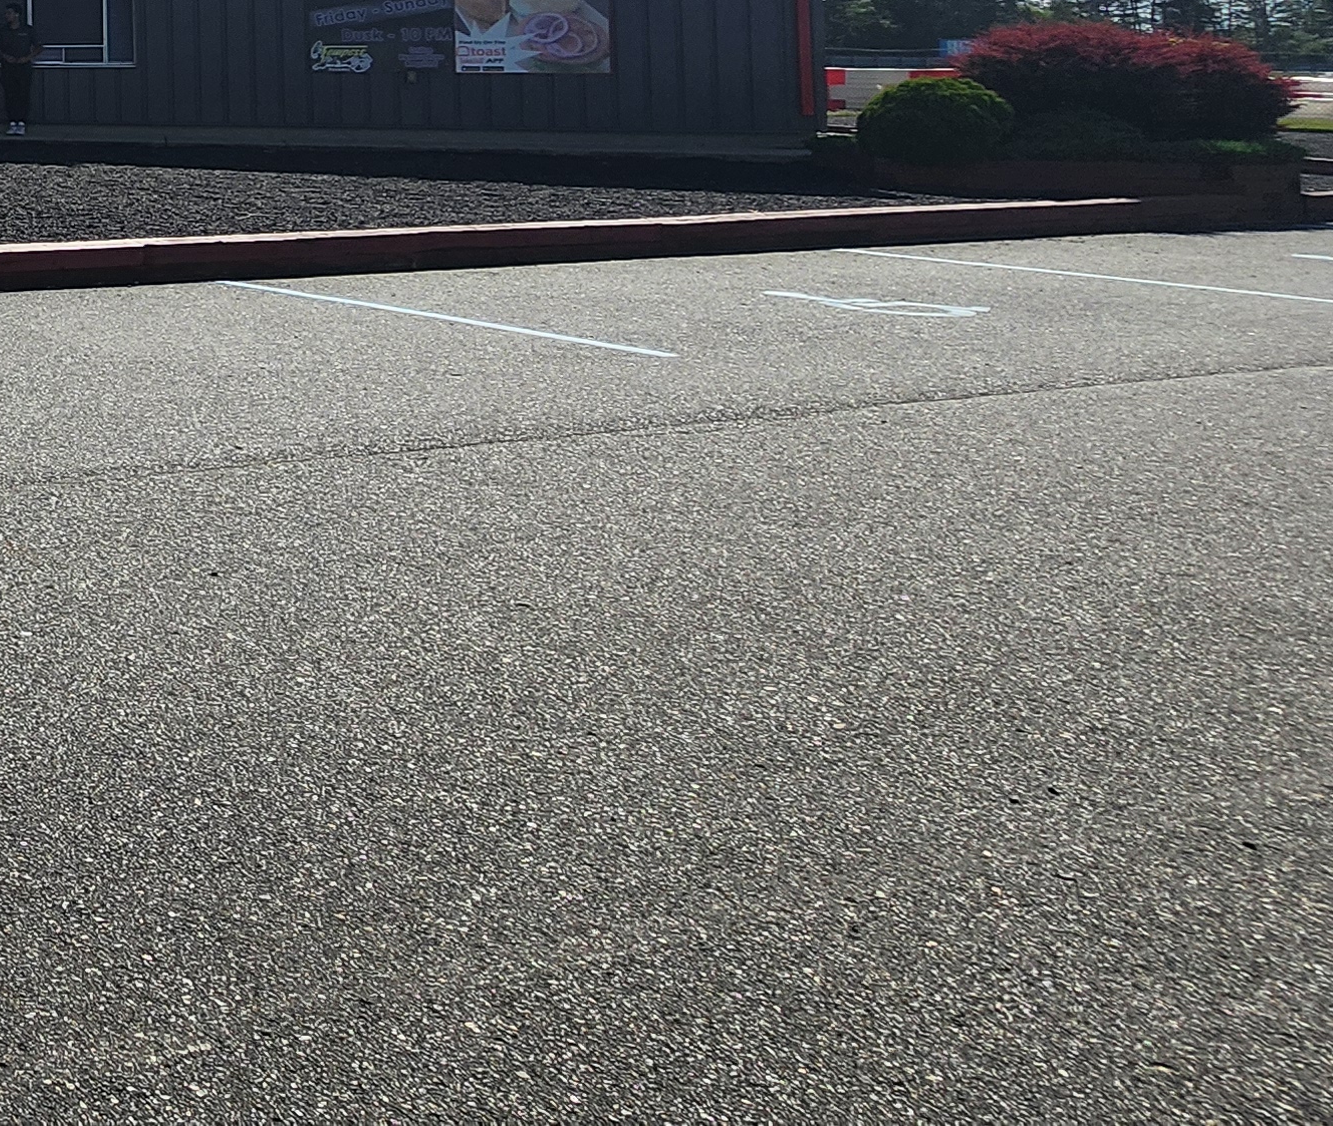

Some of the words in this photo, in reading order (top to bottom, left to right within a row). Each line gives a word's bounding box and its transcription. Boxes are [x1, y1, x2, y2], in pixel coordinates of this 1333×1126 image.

[315, 8, 367, 26] Friday
[341, 27, 384, 42] Dusk
[400, 27, 422, 42] 10
[425, 27, 453, 41] PM
[471, 47, 506, 56] toast
